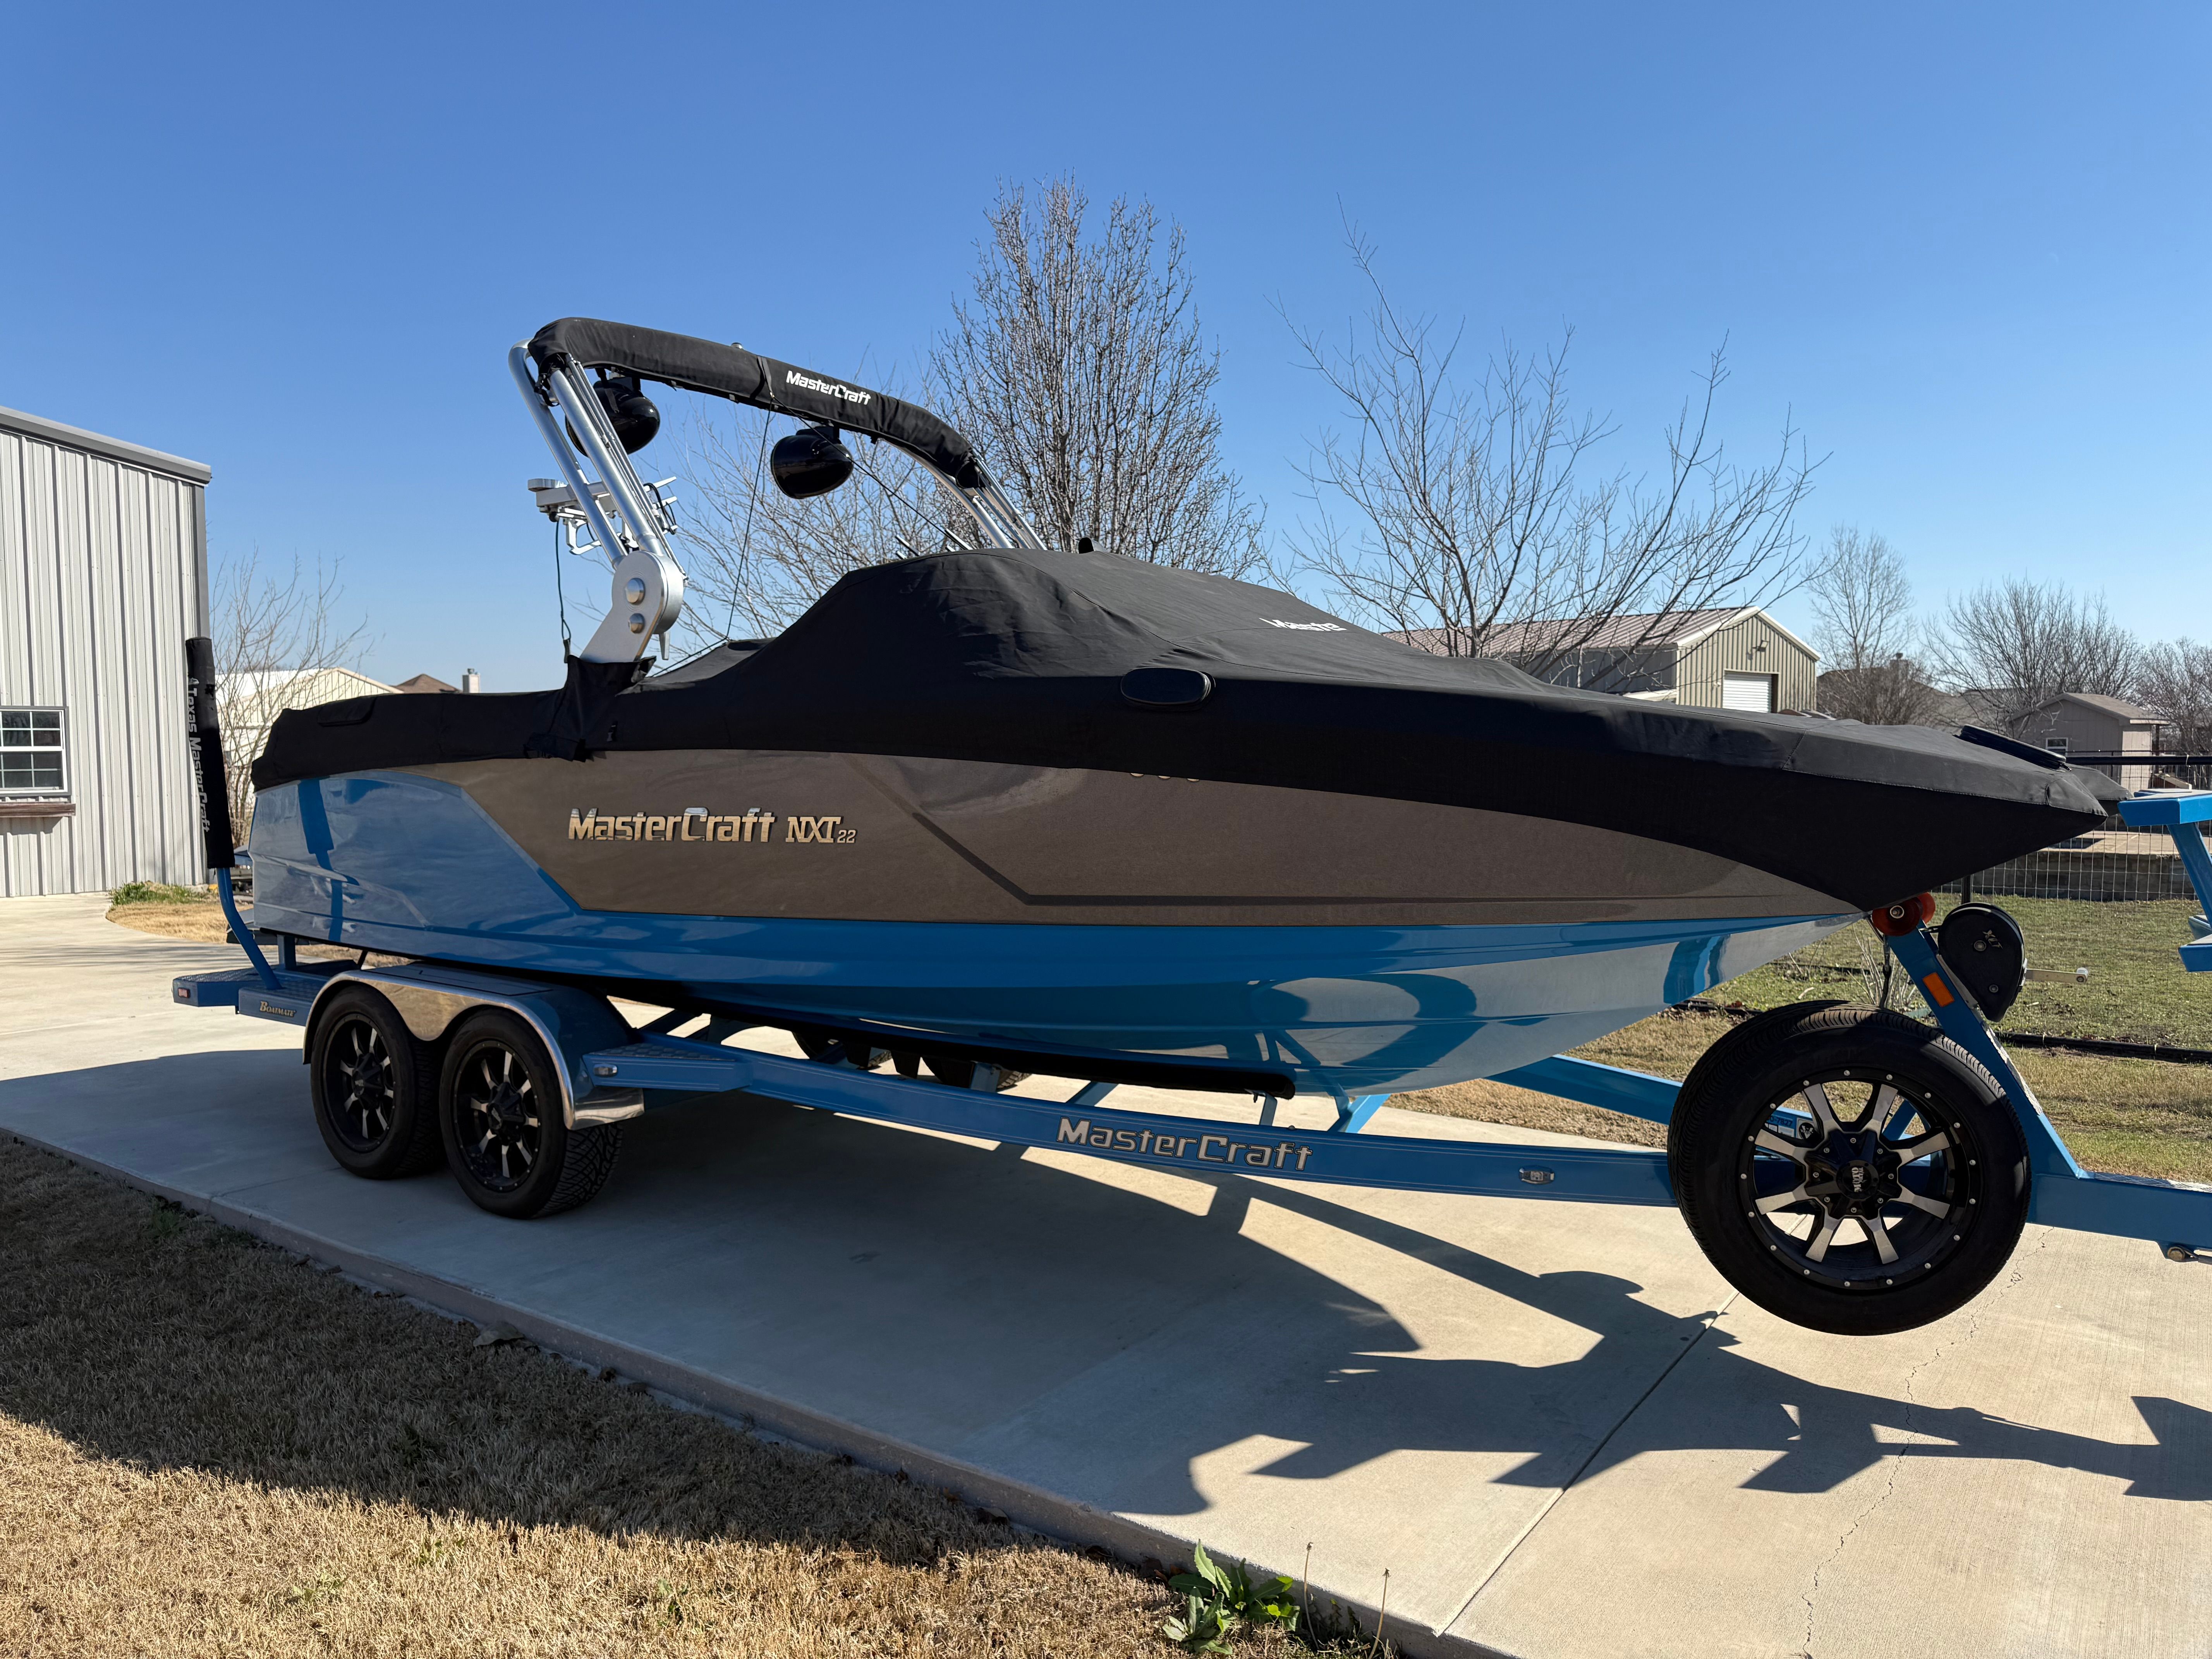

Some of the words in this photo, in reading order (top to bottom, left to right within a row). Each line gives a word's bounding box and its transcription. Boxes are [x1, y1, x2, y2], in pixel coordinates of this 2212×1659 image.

[786, 371, 871, 405] MasterCraft
[188, 688, 198, 732] Texas
[568, 807, 775, 842] MasterCraft
[1056, 1117, 1313, 1171] MasterCraft
[1851, 1167, 1862, 1192] MOTO
